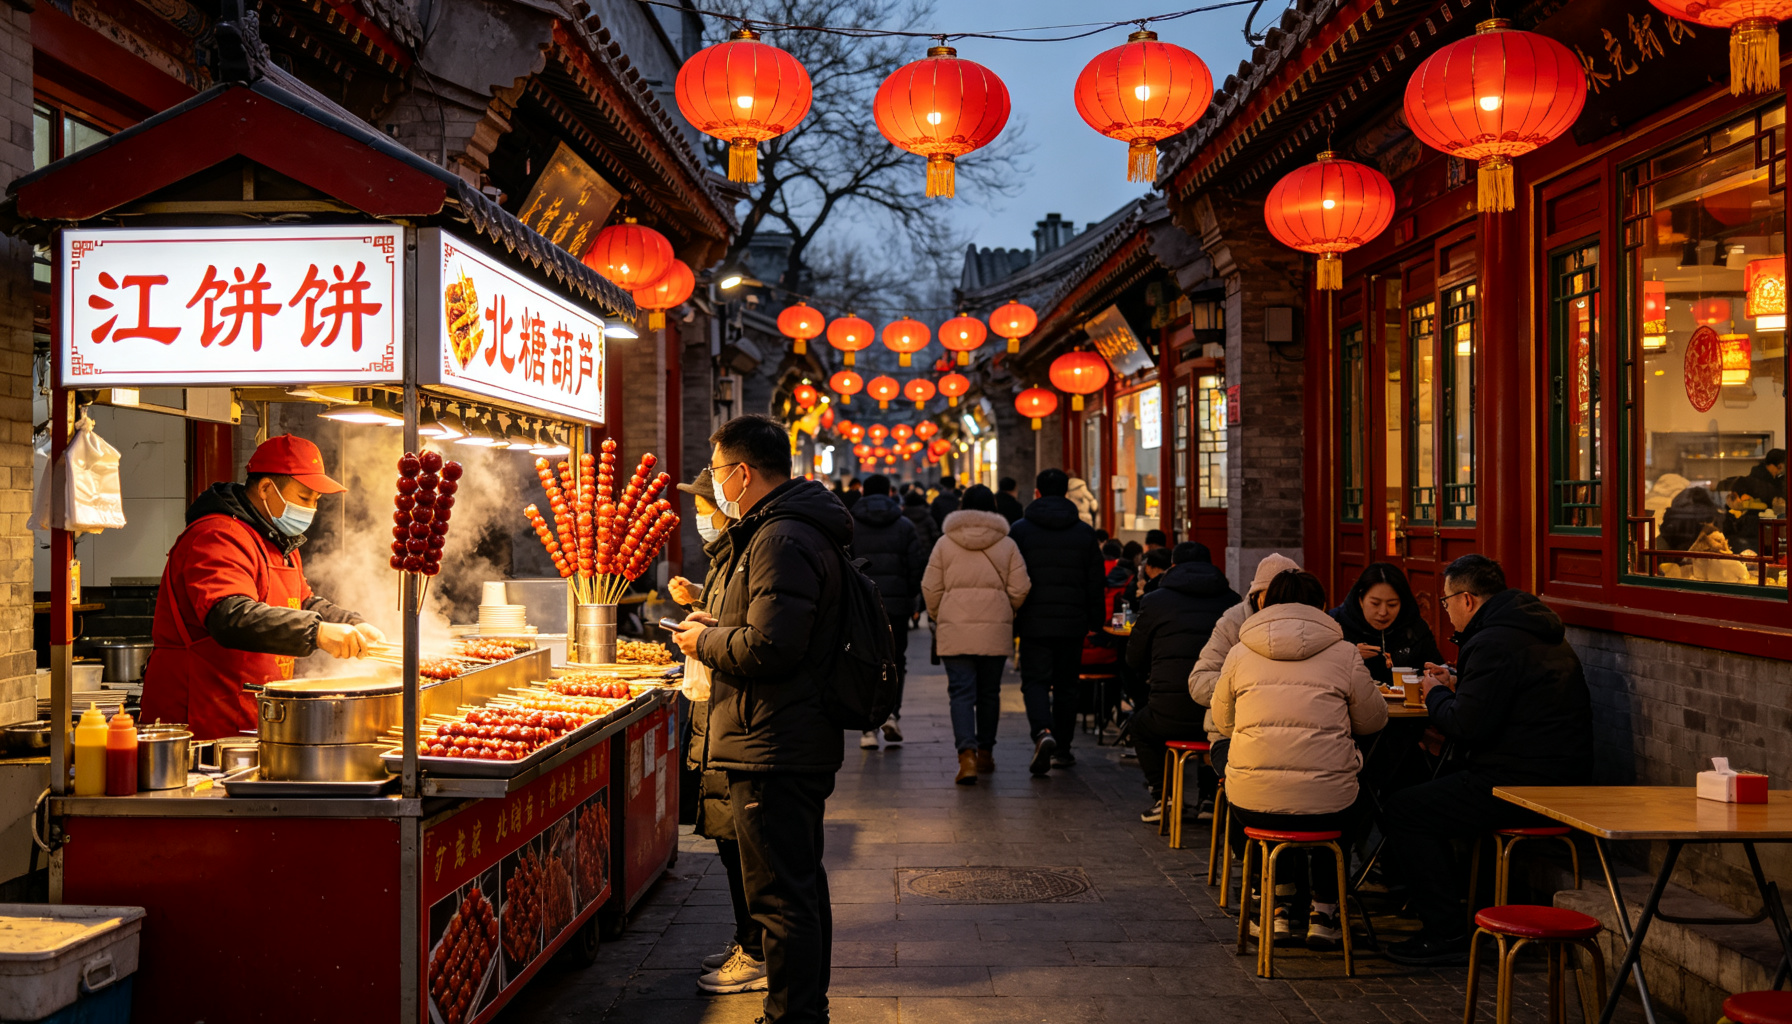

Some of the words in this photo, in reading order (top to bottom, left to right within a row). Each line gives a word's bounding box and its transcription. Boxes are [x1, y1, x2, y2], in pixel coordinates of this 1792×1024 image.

[88, 261, 383, 352] 江饼饼
[485, 294, 593, 395] 北糖葫芦
